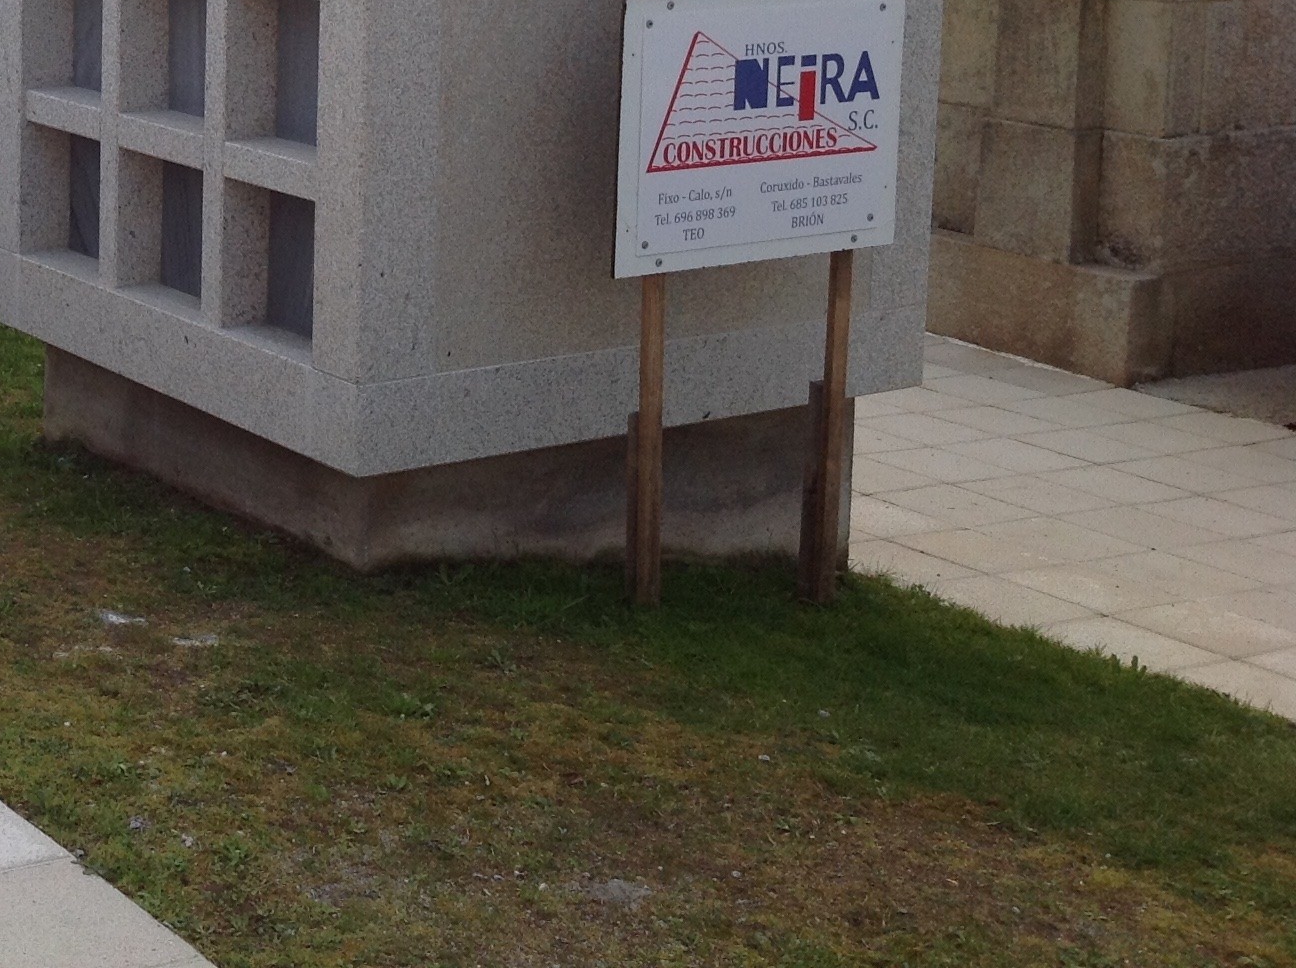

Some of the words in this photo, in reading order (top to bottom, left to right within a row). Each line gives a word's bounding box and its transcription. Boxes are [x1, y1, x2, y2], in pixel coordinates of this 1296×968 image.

[745, 41, 788, 56] HNOS.
[848, 109, 878, 131] S.C.
[663, 127, 838, 165] CONSTRUCCIONES
[760, 180, 805, 194] Coruxido
[813, 172, 862, 188] Bastavales
[688, 189, 713, 204] Calo,
[714, 187, 732, 202] s/n
[771, 200, 788, 212] Tel.
[789, 197, 808, 210] 685
[811, 196, 828, 208] 103
[830, 193, 848, 206] 825
[655, 214, 672, 226] Tel.
[674, 211, 693, 223] 696
[695, 210, 715, 222] 898
[717, 206, 736, 219] 369
[791, 211, 824, 228] BRIÓN
[683, 227, 705, 241] TEO
